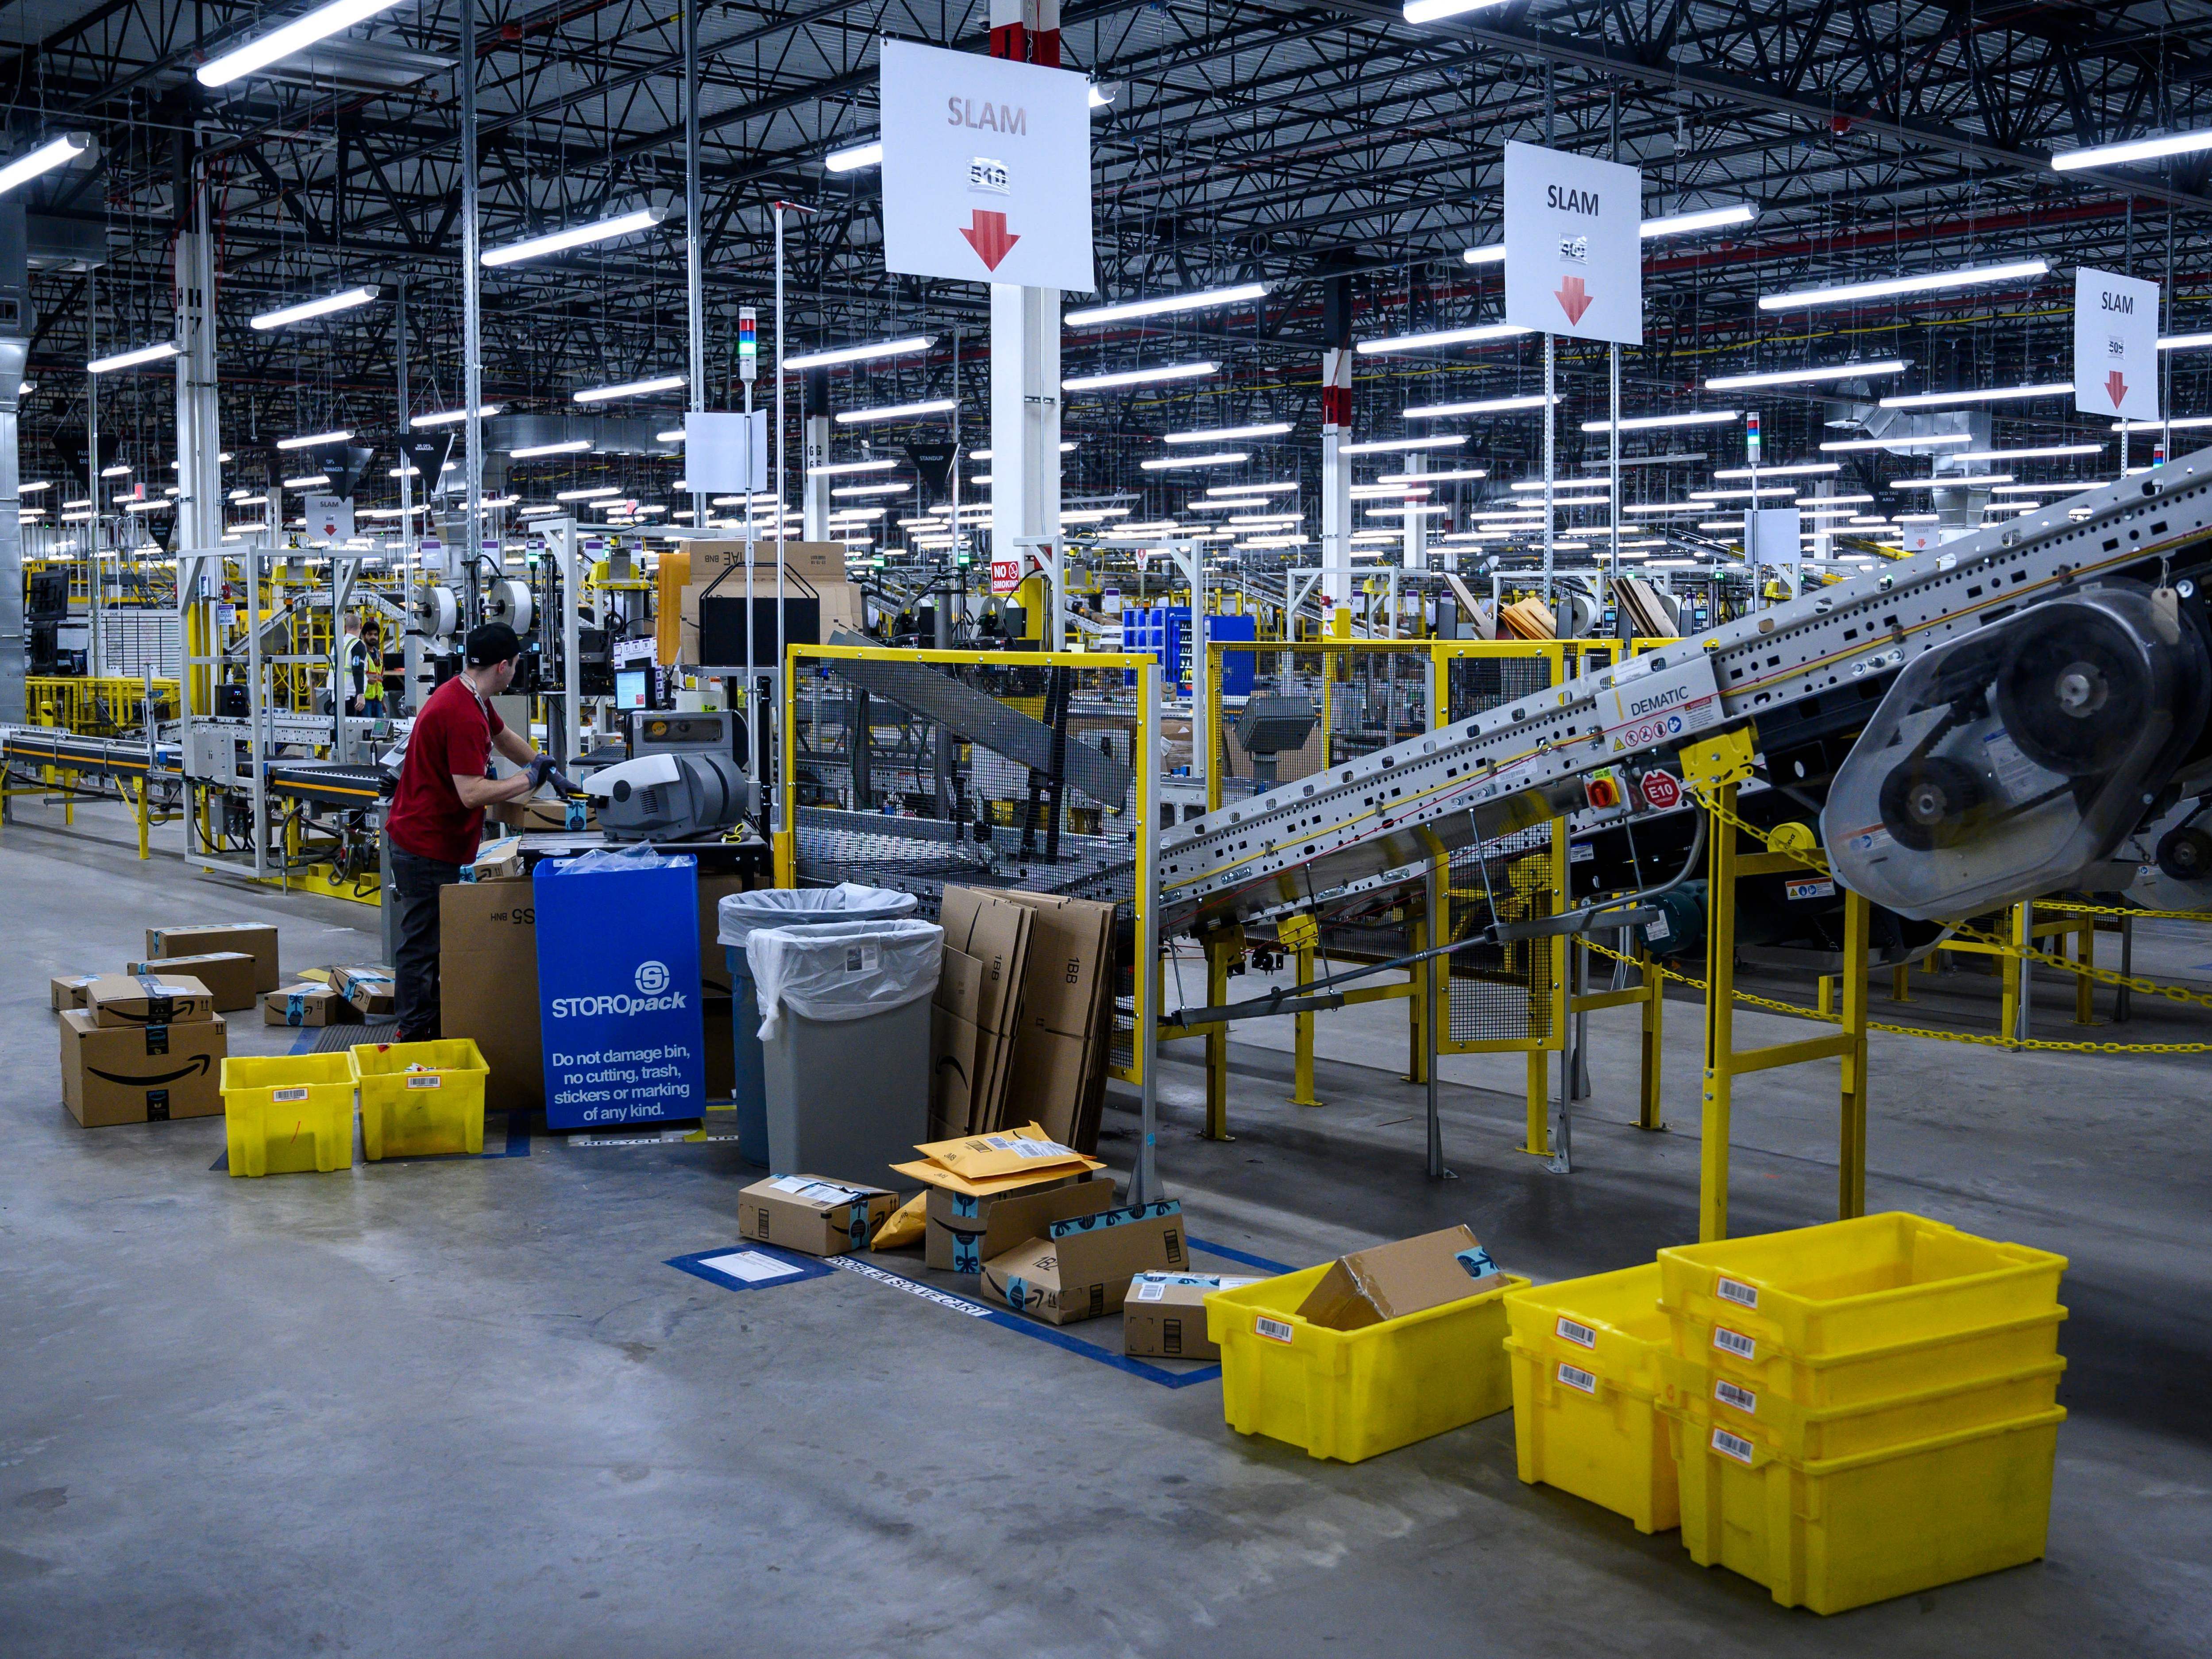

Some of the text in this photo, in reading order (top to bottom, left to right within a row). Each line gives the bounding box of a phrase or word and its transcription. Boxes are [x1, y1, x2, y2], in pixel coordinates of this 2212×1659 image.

[948, 96, 1027, 136] SLAM
[971, 166, 1006, 187] 510
[1548, 185, 1598, 216] SLAM
[178, 287, 183, 306] H
[2101, 291, 2133, 315] SLAM
[178, 315, 183, 334] 7
[809, 445, 814, 456] G
[816, 445, 822, 456] G
[705, 554, 719, 563] BNB
[993, 565, 1007, 578] NO
[993, 580, 1019, 588] SMOKING
[1324, 610, 1335, 618] EXIT
[1631, 686, 1689, 716] DEMATIC
[1648, 784, 1673, 798] E10
[992, 954, 1002, 981] 1BB
[1066, 957, 1080, 984] 1BB
[552, 991, 687, 1018] STOROpack
[553, 1044, 690, 1066] Do not damage bin,
[564, 1063, 681, 1085] no cutting, trash,
[555, 1082, 690, 1104] stickers or marking
[583, 1102, 664, 1123] of any kind.
[1032, 1256, 1058, 1271] 1B2
[830, 1255, 988, 1314] PROBLEM SOLVE CART
